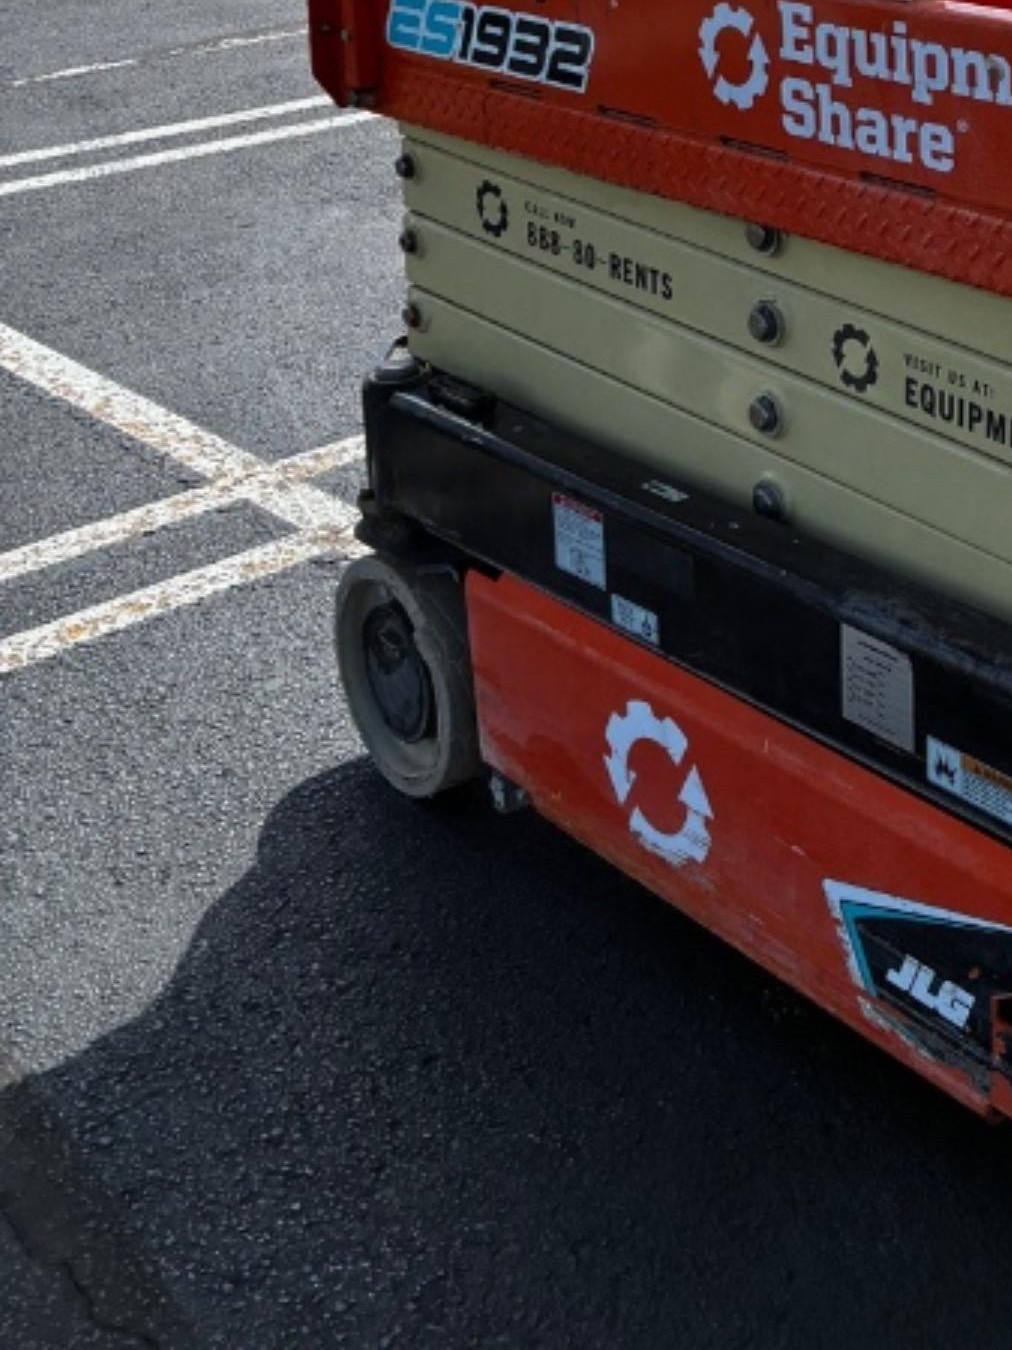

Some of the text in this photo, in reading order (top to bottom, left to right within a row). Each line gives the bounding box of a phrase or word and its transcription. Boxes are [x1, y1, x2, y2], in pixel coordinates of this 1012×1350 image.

[779, 76, 955, 173] Share
[903, 352, 942, 380] VISIT
[947, 368, 967, 388] US
[885, 952, 976, 1029] JLG
